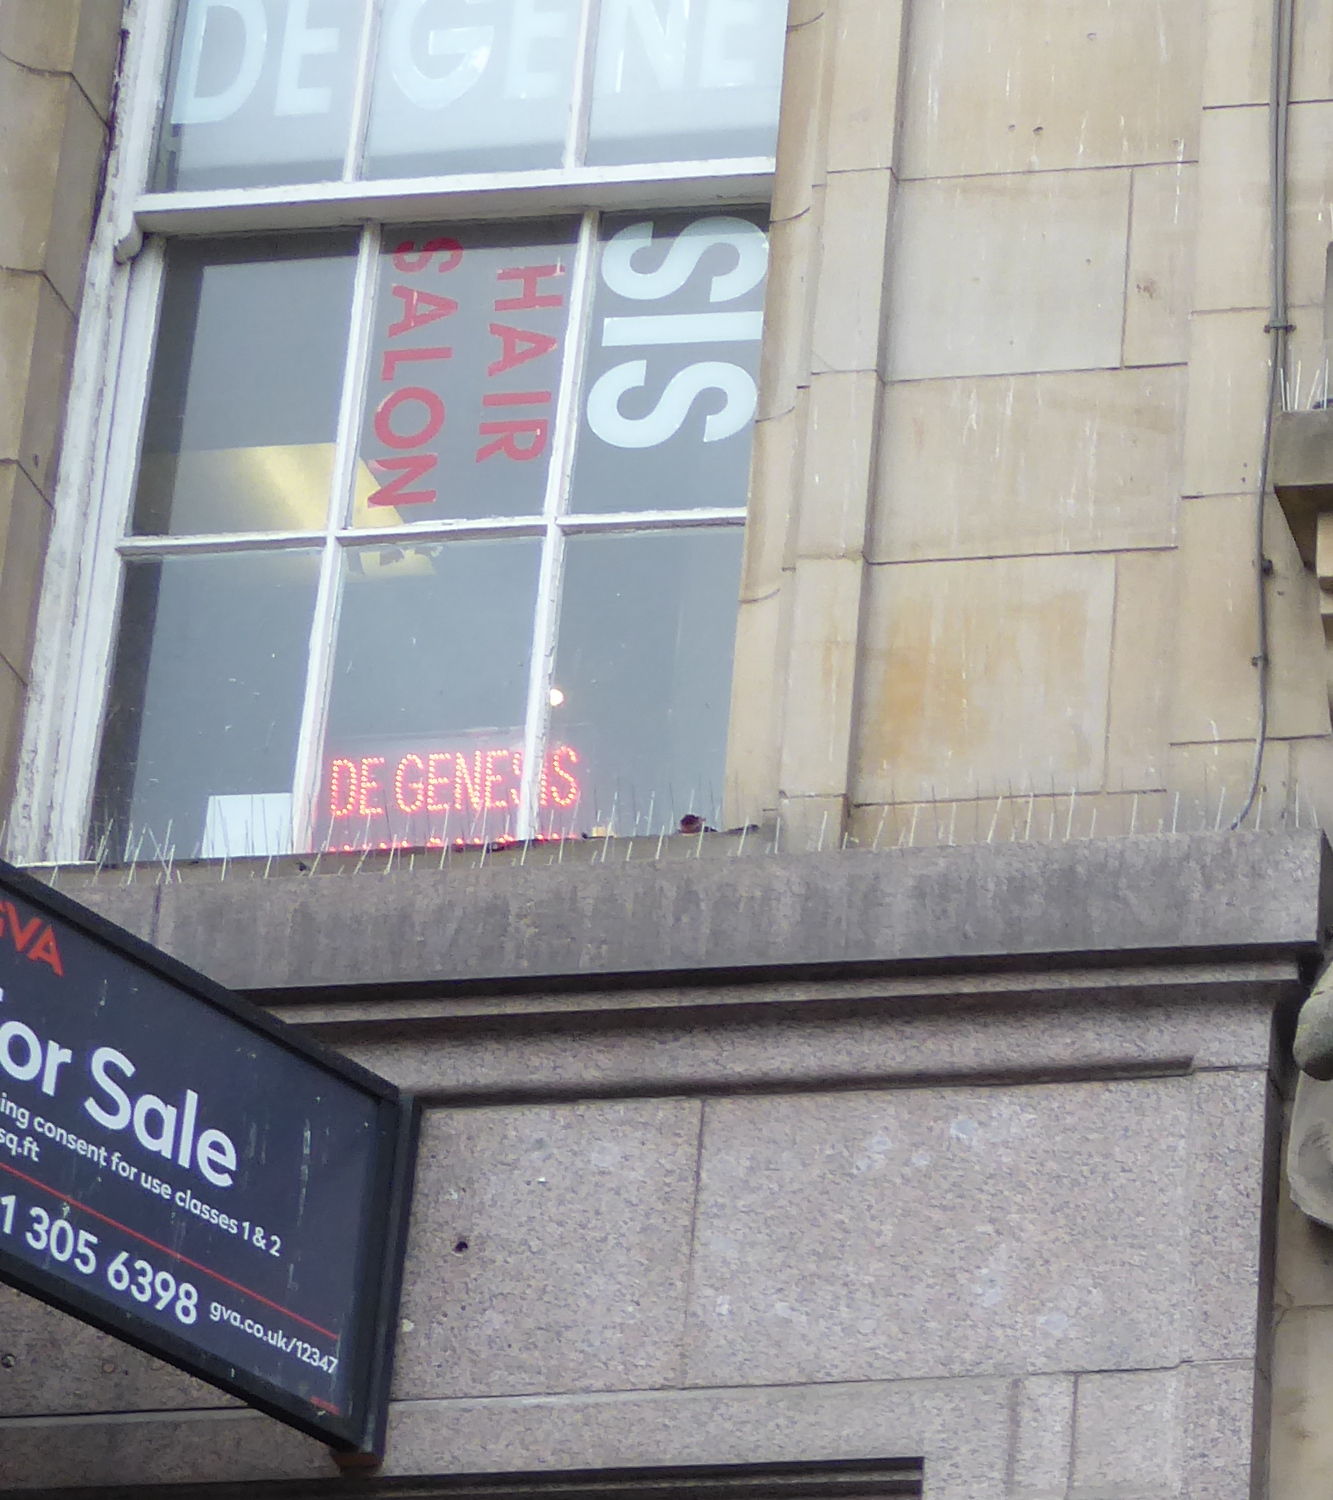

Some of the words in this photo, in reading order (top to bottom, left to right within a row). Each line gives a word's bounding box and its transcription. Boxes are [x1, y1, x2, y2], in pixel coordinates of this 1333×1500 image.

[171, 0, 339, 124] DE
[367, 237, 464, 509] SALON
[475, 263, 566, 463] HAIR
[587, 216, 769, 448] SIS
[330, 757, 385, 816] DE
[0, 900, 64, 977] VA
[33, 1116, 108, 1167] consent
[111, 1152, 139, 1181] for
[140, 1172, 172, 1200] use
[175, 1189, 238, 1235] classes
[242, 1221, 251, 1240] 1
[252, 1227, 267, 1250] &
[269, 1235, 281, 1257] 2
[84, 1047, 237, 1188] Sale
[25, 1206, 99, 1275] 305
[107, 1251, 198, 1325] 6398
